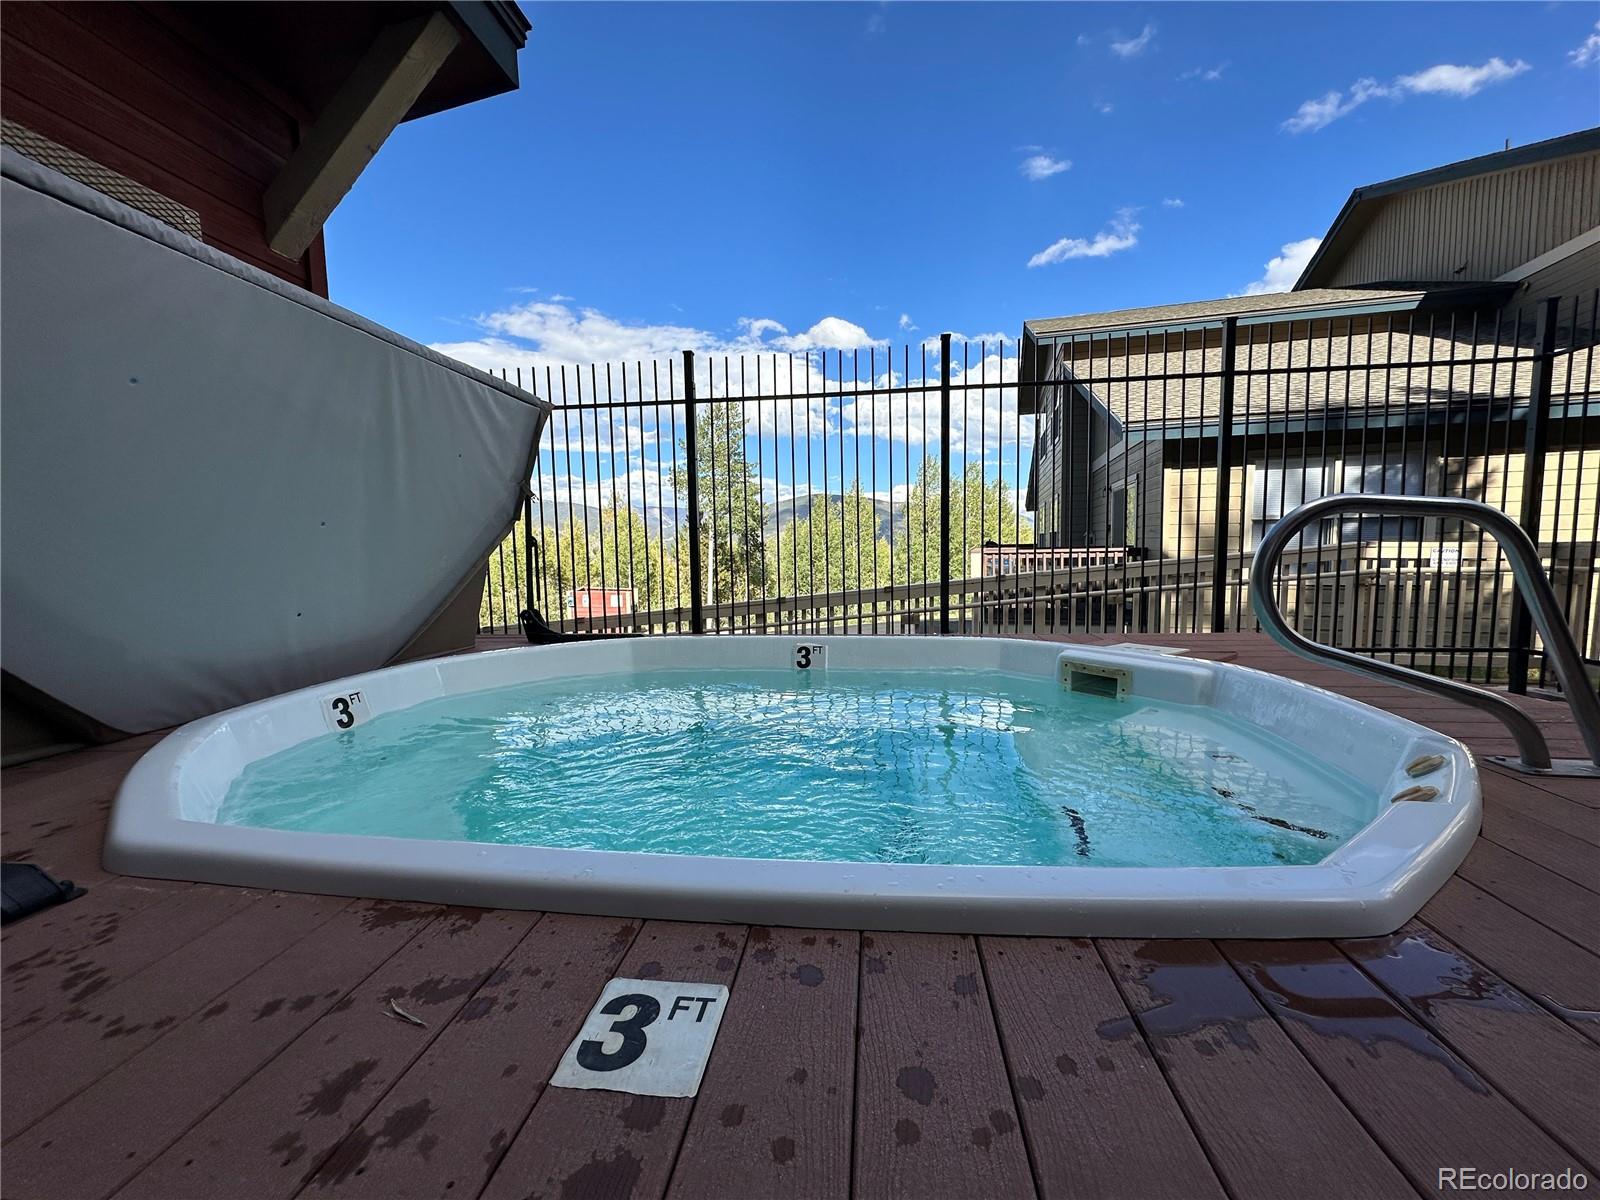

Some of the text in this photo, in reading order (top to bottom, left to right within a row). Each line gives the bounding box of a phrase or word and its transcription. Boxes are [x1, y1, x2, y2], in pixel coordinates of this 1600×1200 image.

[796, 646, 823, 668] 3 FT
[332, 691, 361, 729] 3 FT
[576, 993, 717, 1072] 3 FT
